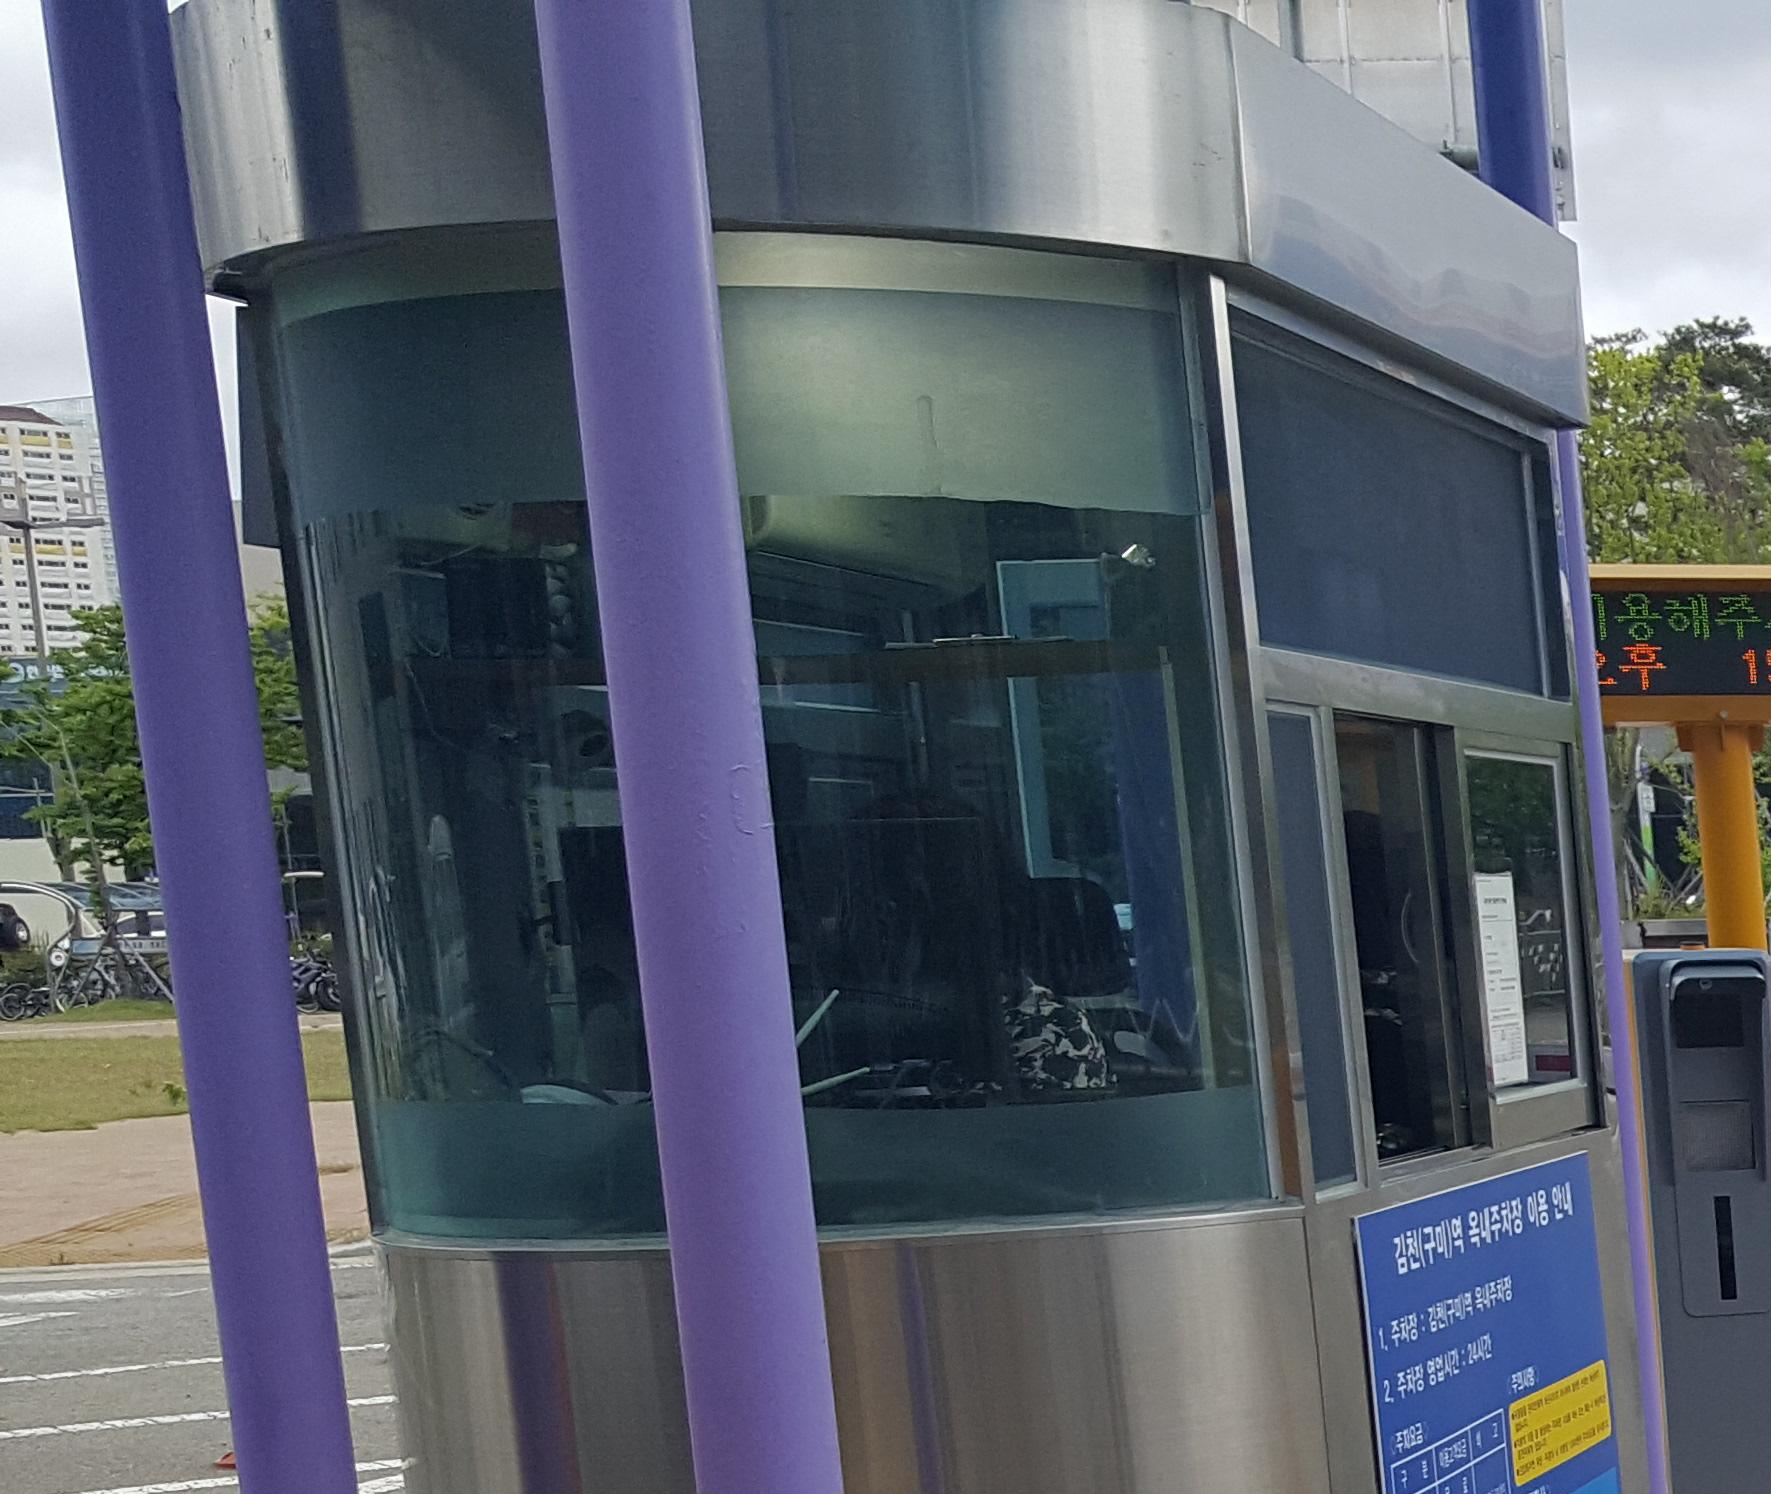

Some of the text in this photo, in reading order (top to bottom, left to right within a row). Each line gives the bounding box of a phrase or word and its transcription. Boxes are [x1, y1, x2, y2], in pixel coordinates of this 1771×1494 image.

[1393, 1181, 1574, 1276] 김천(구미)역 옥내주차장 이용 안내
[1391, 1313, 1419, 1348] 주차장
[1475, 1275, 1513, 1311] 옥내주차장
[1397, 1363, 1425, 1400] 주차장
[1427, 1348, 1460, 1387] 영업시간
[1467, 1332, 1493, 1366] 24시간
